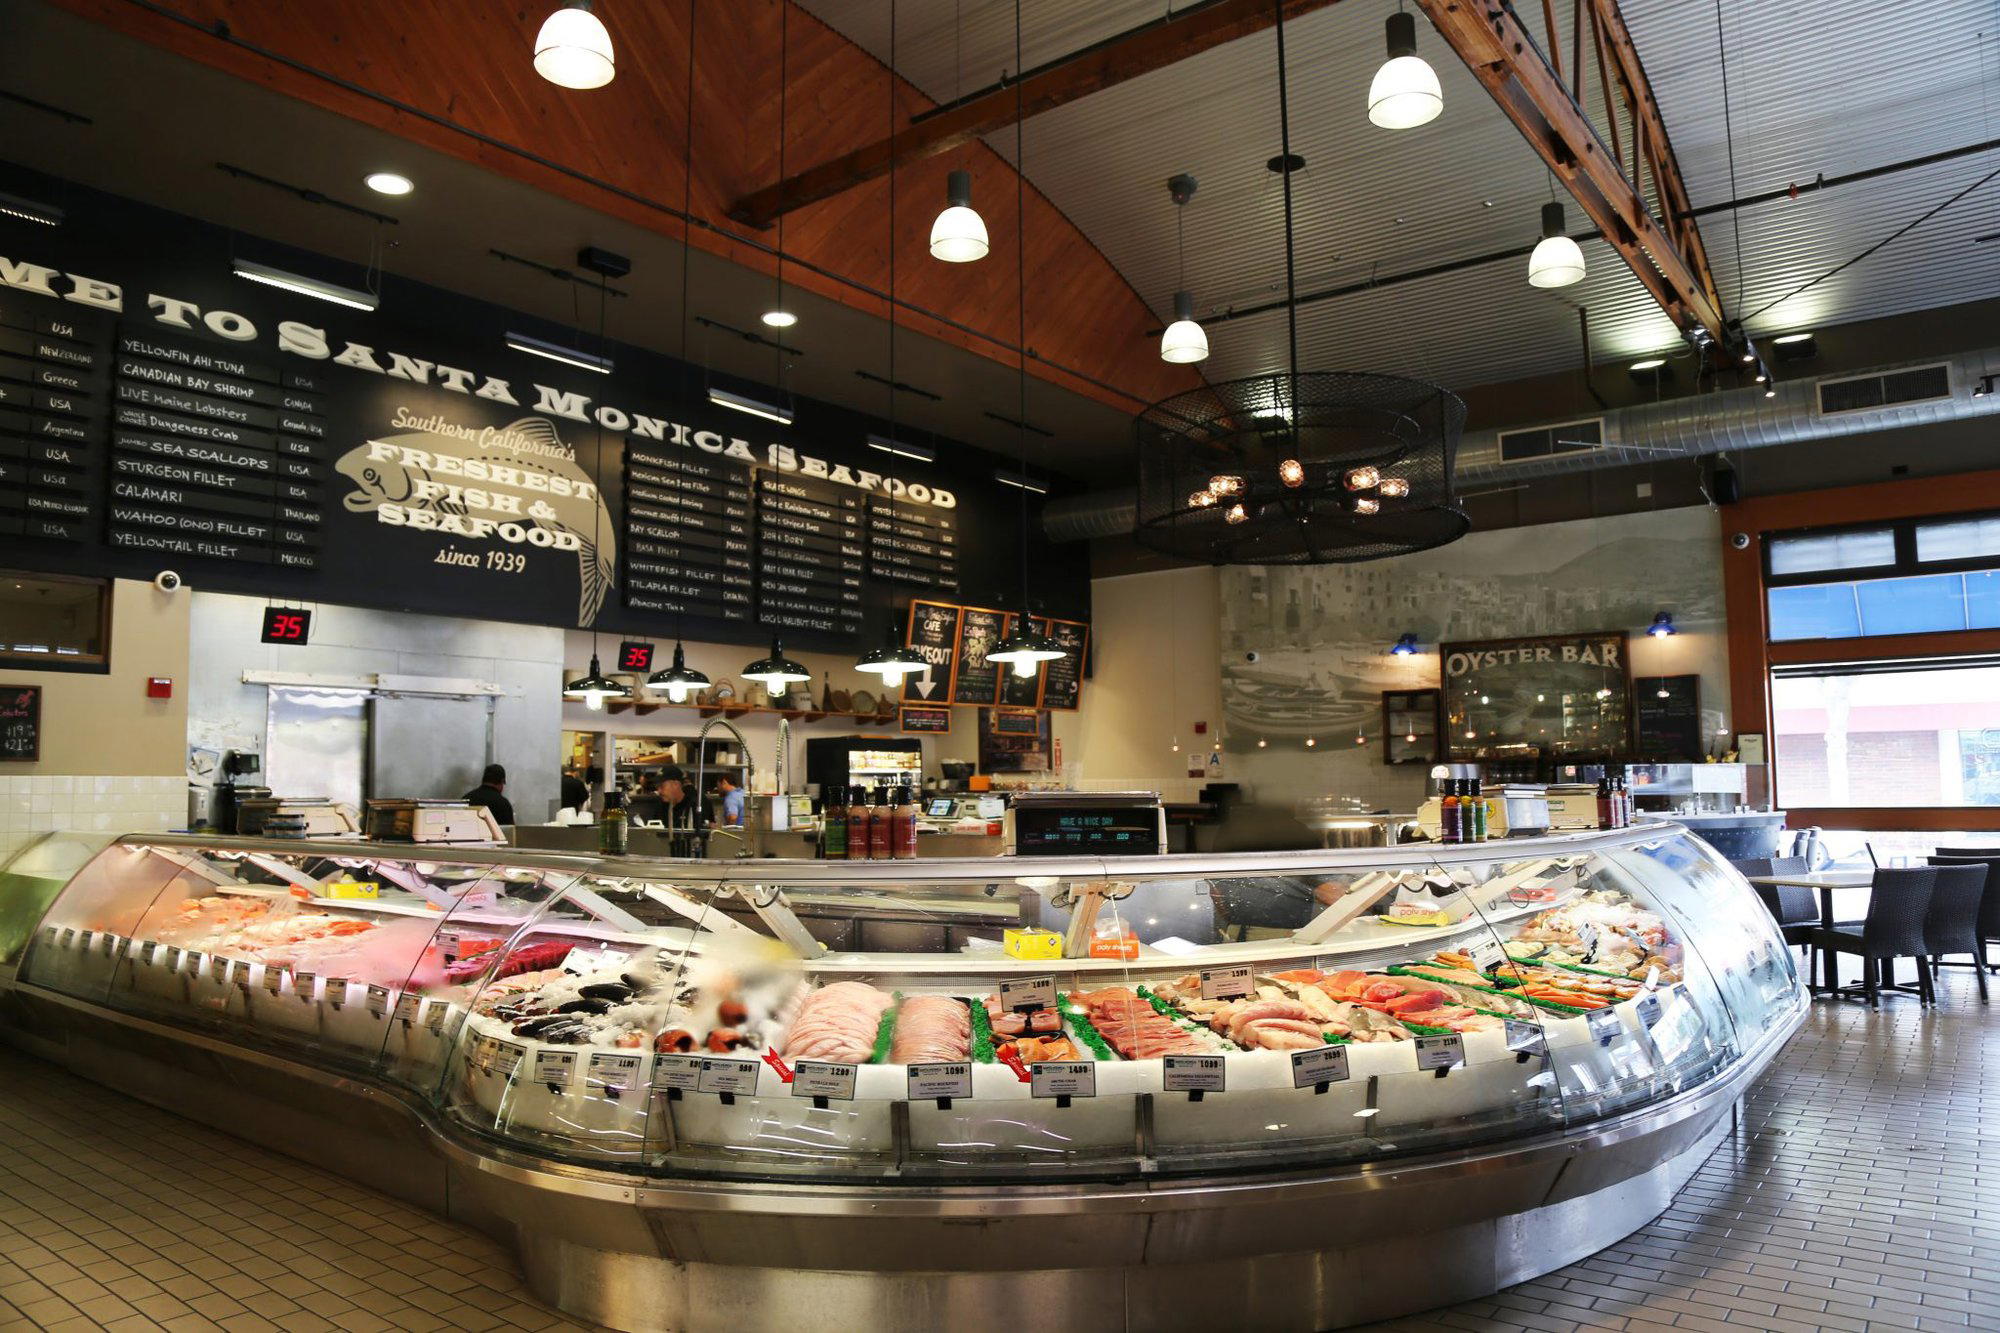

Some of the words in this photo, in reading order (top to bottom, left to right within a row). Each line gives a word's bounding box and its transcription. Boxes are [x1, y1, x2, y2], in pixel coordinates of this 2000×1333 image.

[52, 322, 73, 337] USA
[125, 340, 189, 363] YELLOWFIN
[193, 354, 212, 367] AHI
[214, 360, 245, 375] TUNA
[43, 371, 79, 388] Greece
[123, 363, 182, 386] CANADIAN
[187, 376, 210, 390] BAY
[214, 383, 254, 398] SHRIMP
[50, 397, 72, 412] USA
[121, 386, 149, 402] LIVE
[154, 394, 192, 411] Maine
[196, 401, 247, 422] Lobsters
[148, 293, 259, 341] TO
[278, 320, 520, 406] SANTA
[532, 383, 757, 462] MONICA
[767, 443, 957, 509] SEAFOOD
[284, 398, 312, 412] CANADA
[150, 416, 208, 437] Dungeness
[211, 428, 239, 441] Crab
[391, 407, 475, 443] Southern
[479, 425, 576, 463] California's
[46, 448, 70, 463] USA
[150, 442, 184, 457] SEA
[187, 448, 269, 470] SCALLOPS
[632, 452, 679, 469] MONKFISH
[681, 463, 711, 475] FILLET
[118, 460, 190, 481] STURGEON
[194, 471, 236, 487] FILLET
[289, 465, 310, 476] USA
[367, 440, 598, 501] FRESHEST
[115, 483, 183, 503] CALAMARI
[289, 486, 308, 498] USA
[413, 478, 523, 515] FISH
[527, 500, 557, 521] &
[762, 497, 783, 509] Whoe
[43, 523, 69, 538] USA
[114, 509, 177, 526] WAHOO
[217, 523, 267, 538] FILLET
[377, 503, 582, 552] SEAFOOD
[115, 533, 192, 552] YELLOWTAIL
[197, 543, 238, 557] FILLET
[285, 531, 305, 544] USA
[434, 545, 480, 568] since
[486, 550, 526, 574] 1939
[686, 569, 716, 580] FILLET
[630, 580, 668, 593] TILAPIA
[268, 615, 301, 638] 35
[760, 614, 781, 624] LOCL
[626, 648, 649, 667] 35
[1446, 647, 1554, 677] OYSTER
[1561, 643, 1623, 670] BAR
[1210, 752, 1220, 765] A
[1084, 817, 1100, 826] NICE
